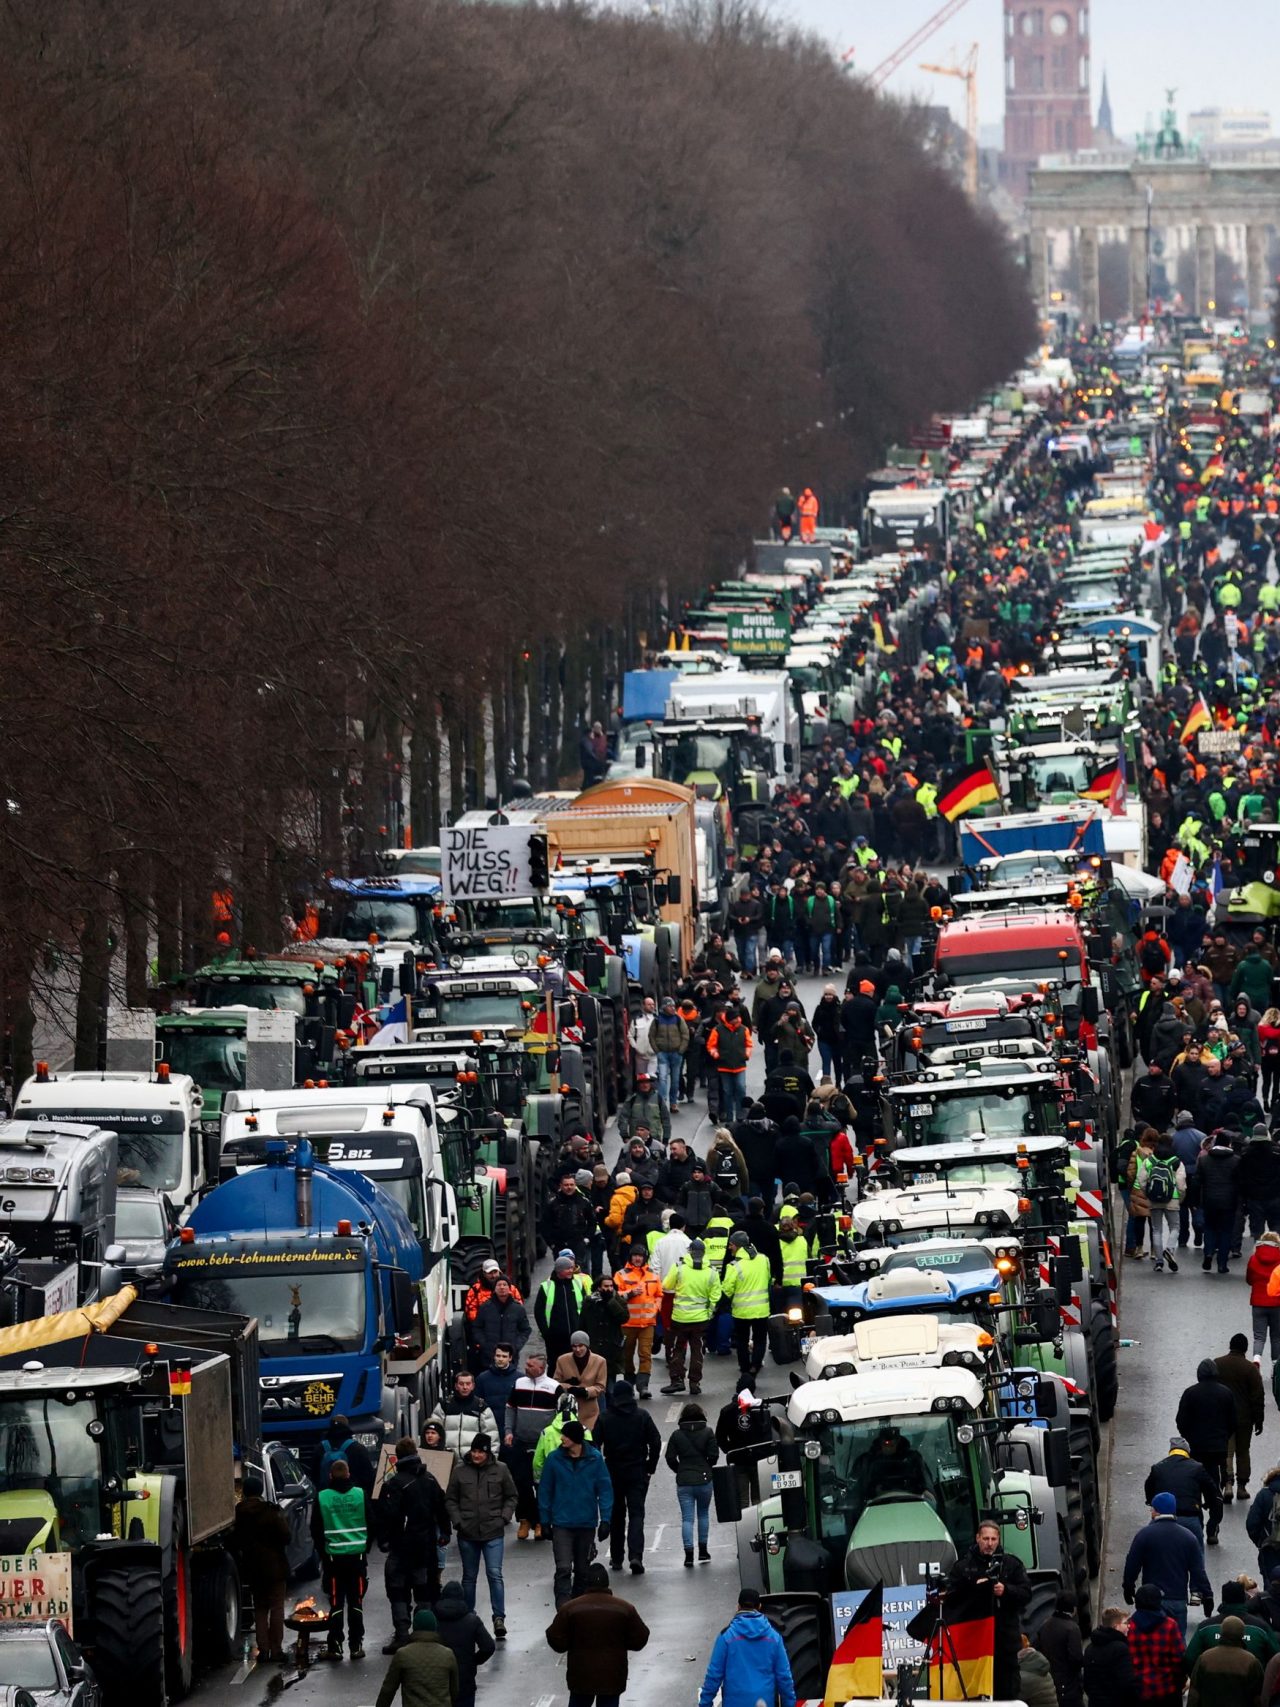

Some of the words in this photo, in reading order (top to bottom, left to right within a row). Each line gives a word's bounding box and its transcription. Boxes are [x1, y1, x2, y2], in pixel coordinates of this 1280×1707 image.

[765, 627, 786, 639] Bier
[447, 828, 489, 851] DIE
[448, 850, 511, 871] MUSS
[449, 868, 519, 897] WEG!!
[328, 1143, 373, 1160] S.BIZ
[915, 1252, 963, 1266] FENDT
[262, 1397, 301, 1410] AN
[305, 1394, 334, 1403] BEHR
[1, 1558, 38, 1573] DER
[836, 1607, 852, 1618] ES
